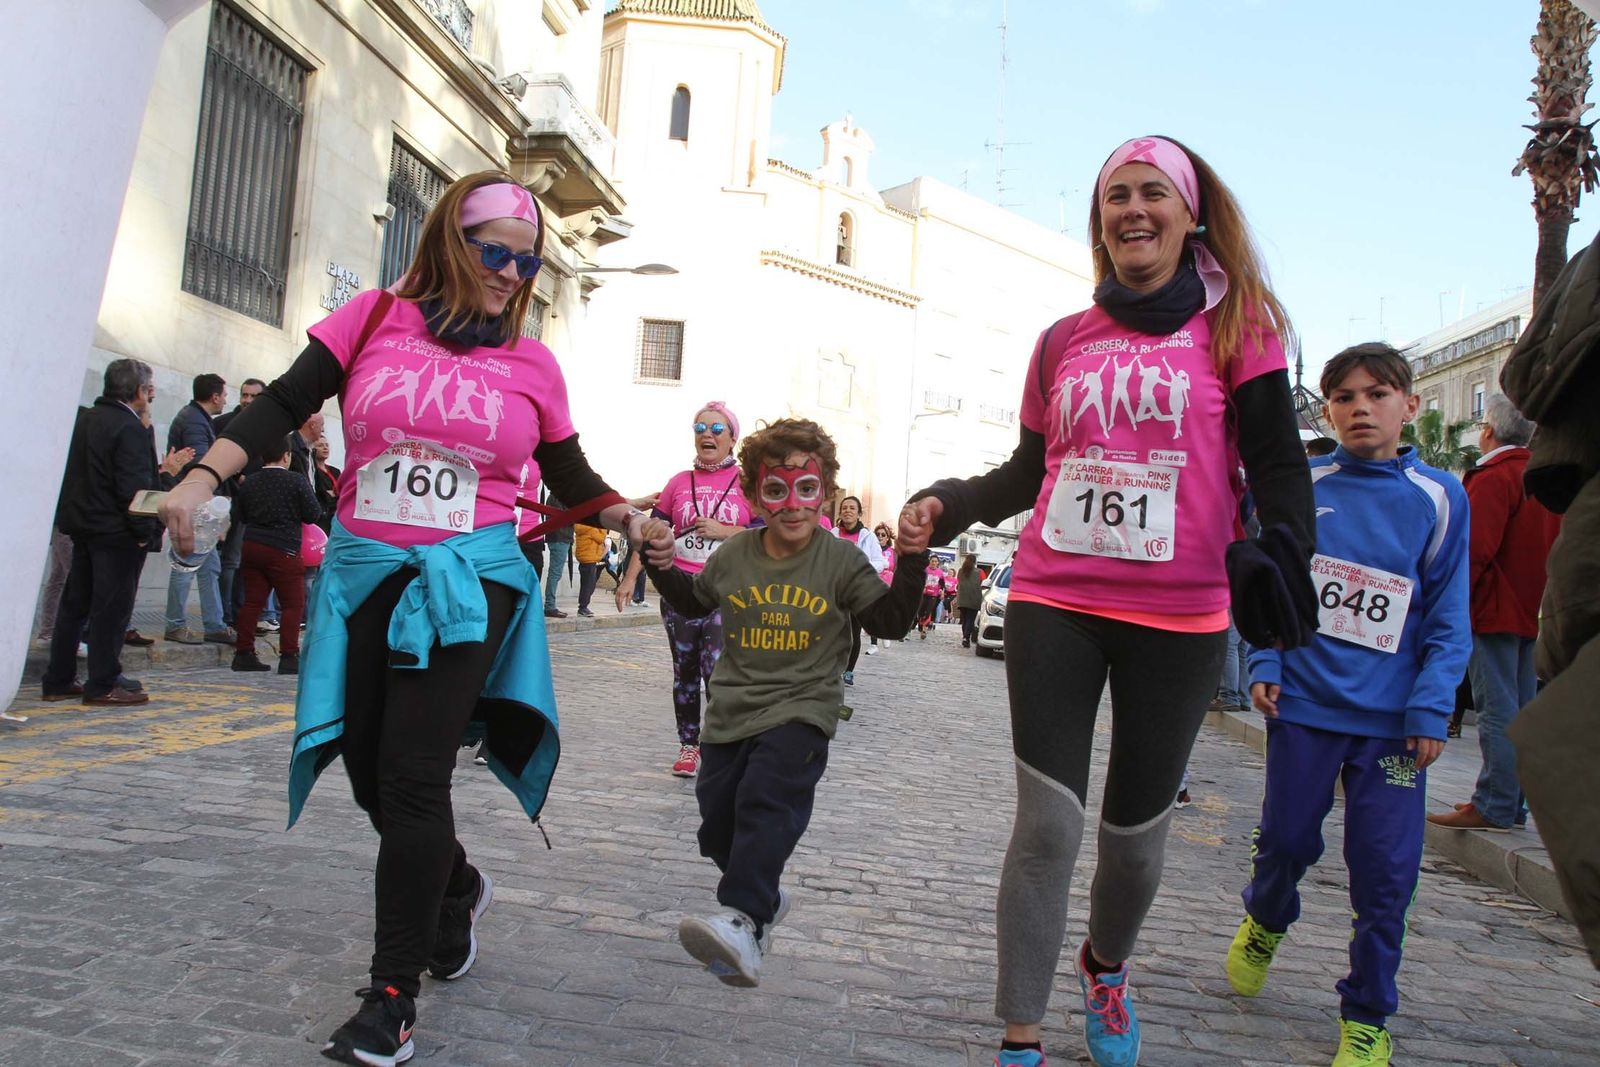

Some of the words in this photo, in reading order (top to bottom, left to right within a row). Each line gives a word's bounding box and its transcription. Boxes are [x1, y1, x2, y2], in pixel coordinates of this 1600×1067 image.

[329, 262, 359, 289] PLAZA
[337, 278, 349, 294] DE
[405, 336, 452, 357] CARRERA
[487, 357, 512, 372] PINK
[1081, 338, 1130, 354] CARRERA
[1167, 330, 1192, 340] INK
[383, 339, 397, 348] DE
[397, 343, 411, 353] LA
[460, 356, 512, 378] RUNNING
[392, 449, 421, 459] MUJER
[1151, 452, 1185, 463] ekiden
[384, 461, 458, 500] 160
[1124, 477, 1171, 491] RUNNING
[1147, 471, 1171, 481] PINK
[1075, 488, 1148, 529] 161
[1325, 560, 1362, 576] CARRERA
[1388, 578, 1408, 589] PINK
[1331, 571, 1360, 583] MUJER
[1368, 580, 1408, 596] RUNNING
[727, 584, 828, 615] NACIDO
[1320, 581, 1390, 623] 648
[761, 612, 790, 626] PARA
[741, 627, 810, 651] LUCHAR
[1378, 755, 1400, 768] NEW
[1394, 765, 1410, 780] 98
